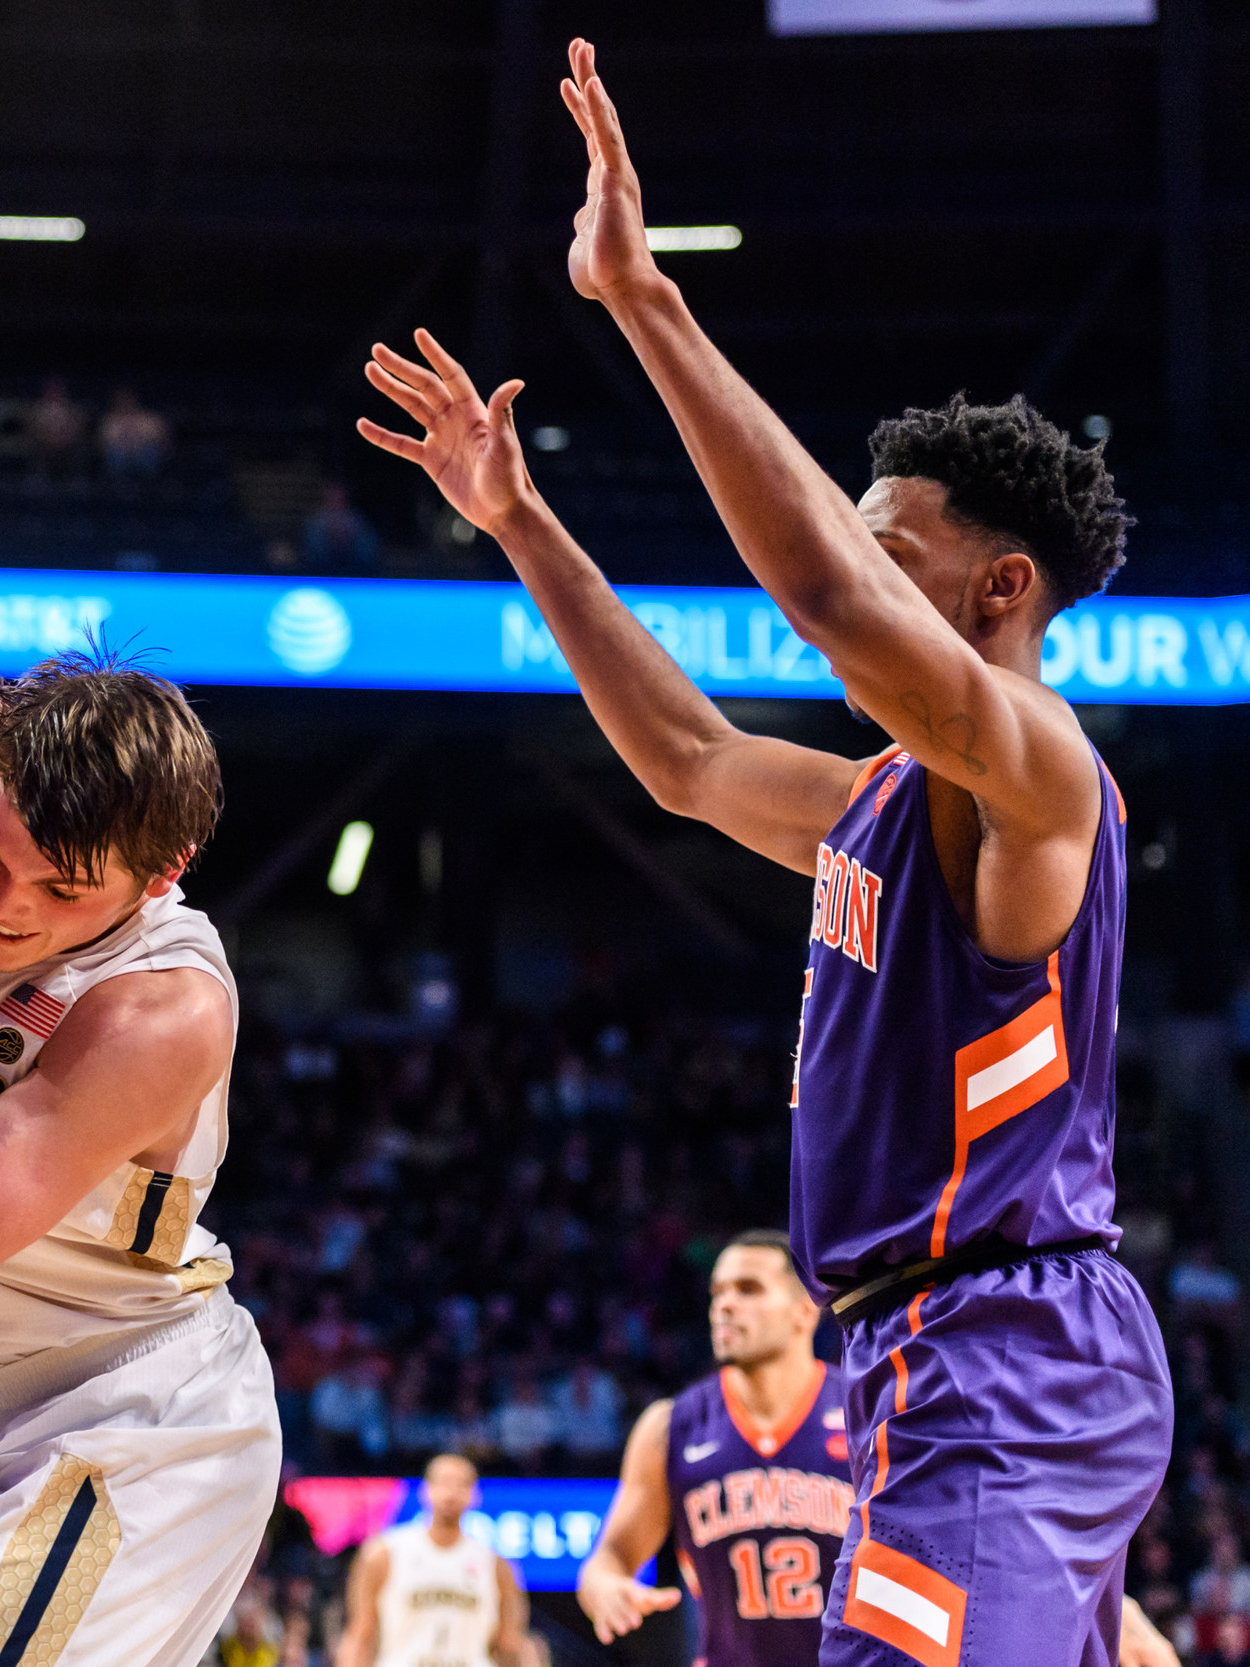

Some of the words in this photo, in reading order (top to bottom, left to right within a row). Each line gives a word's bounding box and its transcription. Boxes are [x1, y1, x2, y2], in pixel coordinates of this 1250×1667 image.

[501, 601, 842, 681] MBILIZ
[810, 842, 882, 973] SON
[683, 1466, 856, 1548] CLEMSON
[729, 1536, 825, 1620] 12
